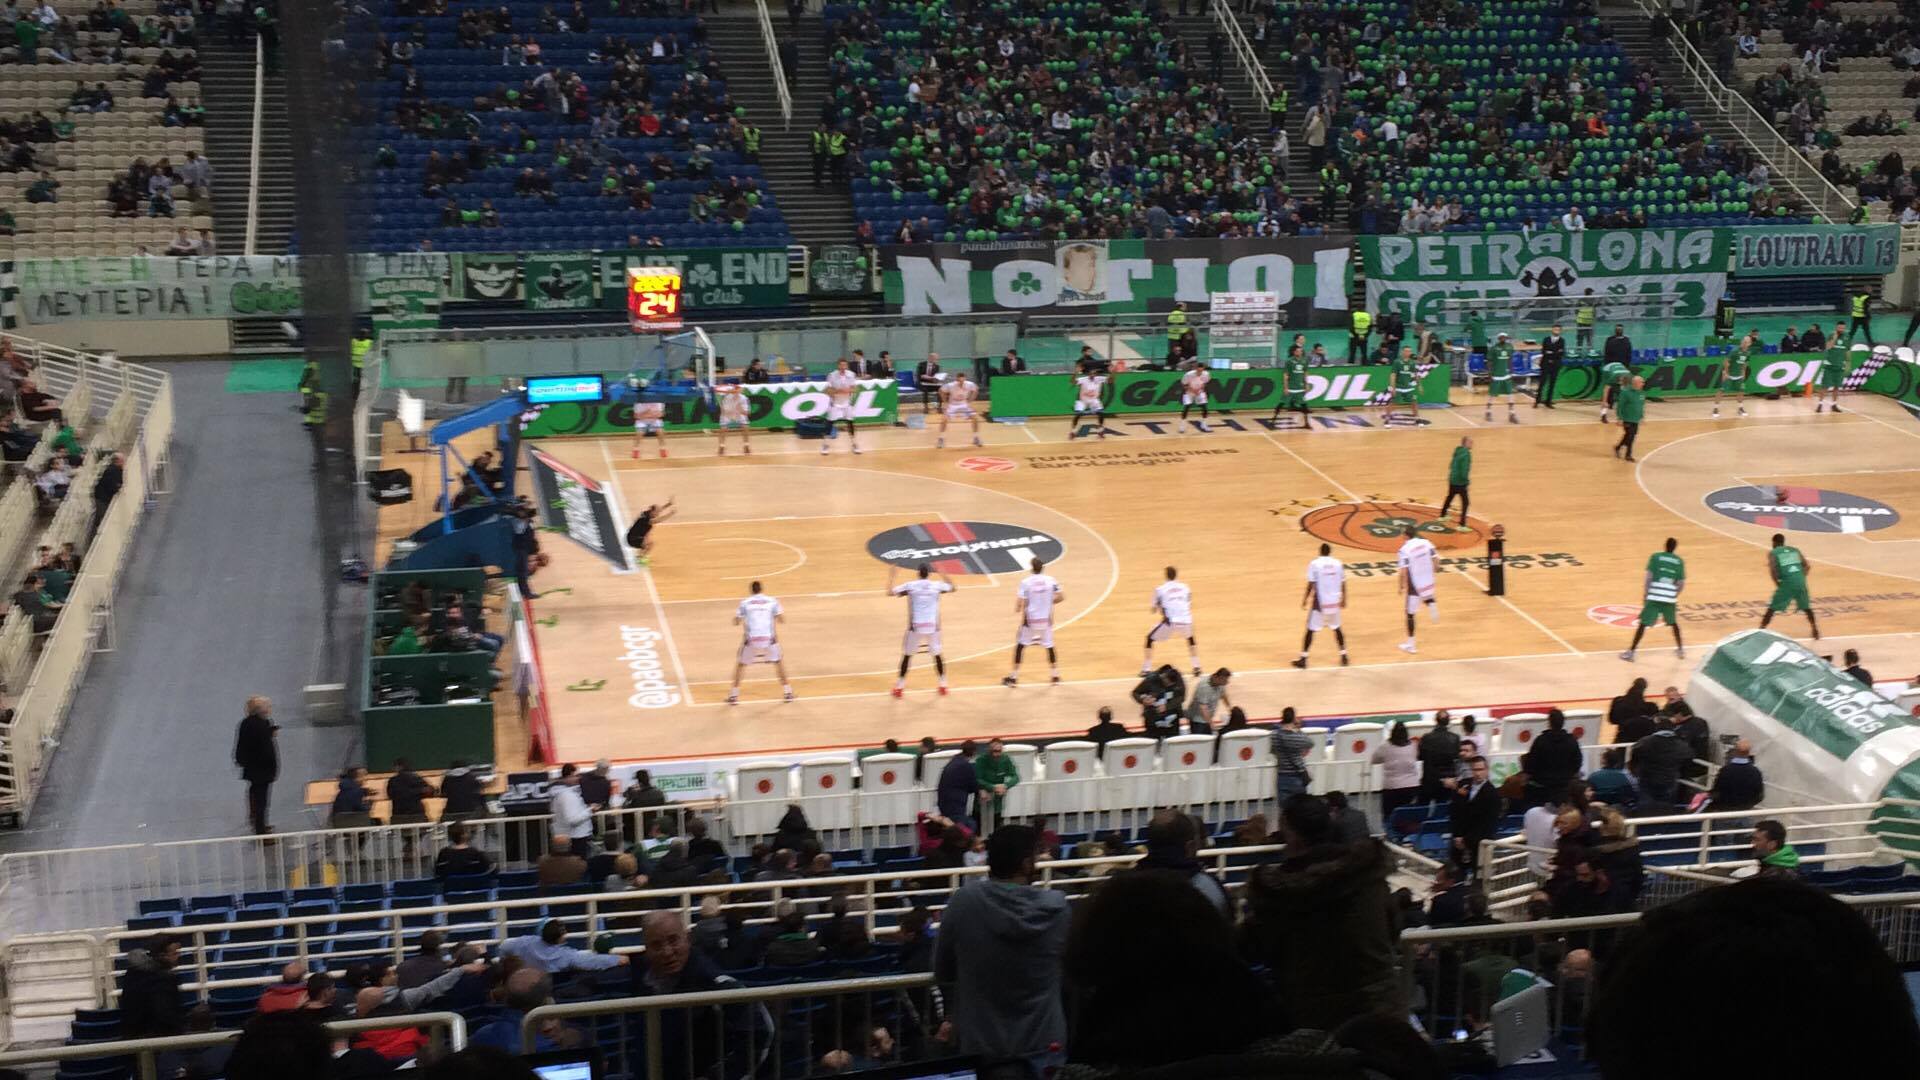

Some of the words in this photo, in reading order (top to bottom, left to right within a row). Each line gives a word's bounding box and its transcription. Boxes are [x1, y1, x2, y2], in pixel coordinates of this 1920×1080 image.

[1378, 229, 1715, 276] PETRALONA
[1743, 233, 1867, 268] LOUTRAKI
[1875, 238, 1895, 267] 13
[722, 252, 788, 285] END
[639, 292, 677, 316] 24
[1025, 453, 1130, 463] TURKISH
[1136, 448, 1240, 458] AIRLINES
[1029, 456, 1188, 470] EuroLeague
[617, 624, 682, 709] @paobcgr
[1803, 685, 1887, 734] adidas
